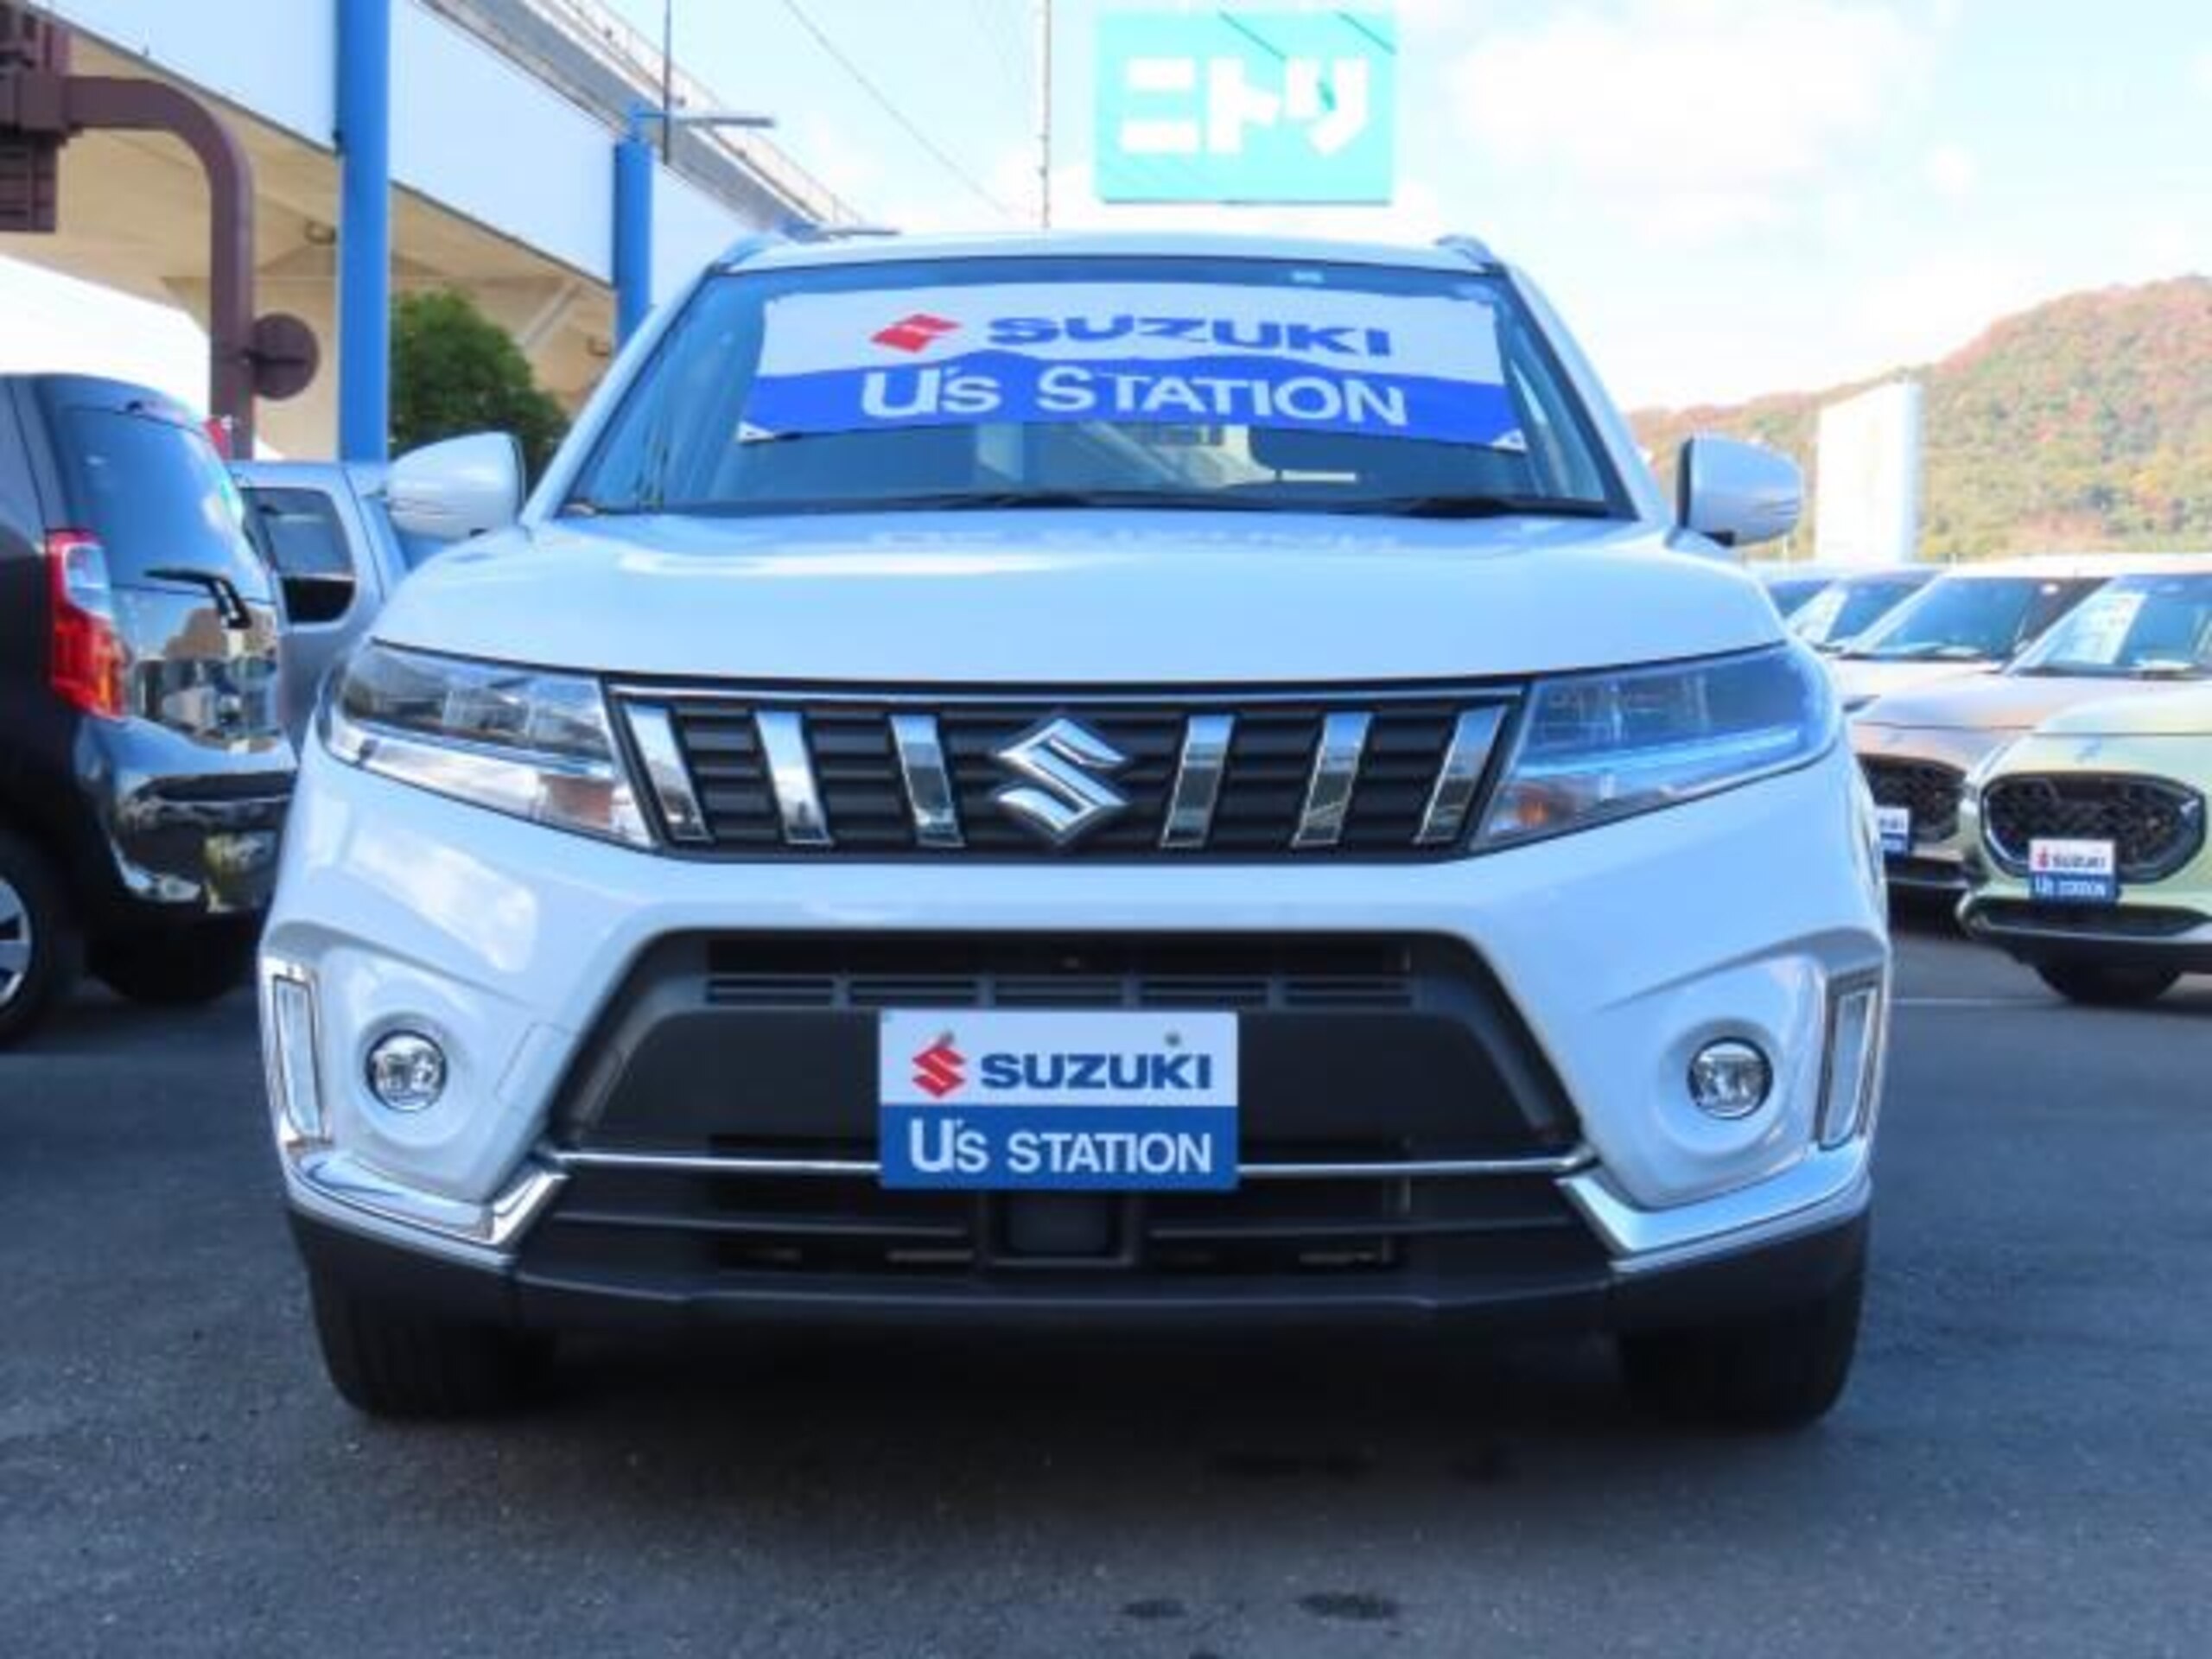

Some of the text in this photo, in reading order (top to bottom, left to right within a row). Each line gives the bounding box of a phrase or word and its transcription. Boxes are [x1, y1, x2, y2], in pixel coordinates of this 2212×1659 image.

[1119, 56, 1370, 157] ニトリ
[987, 314, 1392, 357] SUZUKI
[1038, 365, 1408, 426] STATION
[980, 1053, 1212, 1090] SUZUKI
[910, 1118, 1212, 1173] U's STATION
